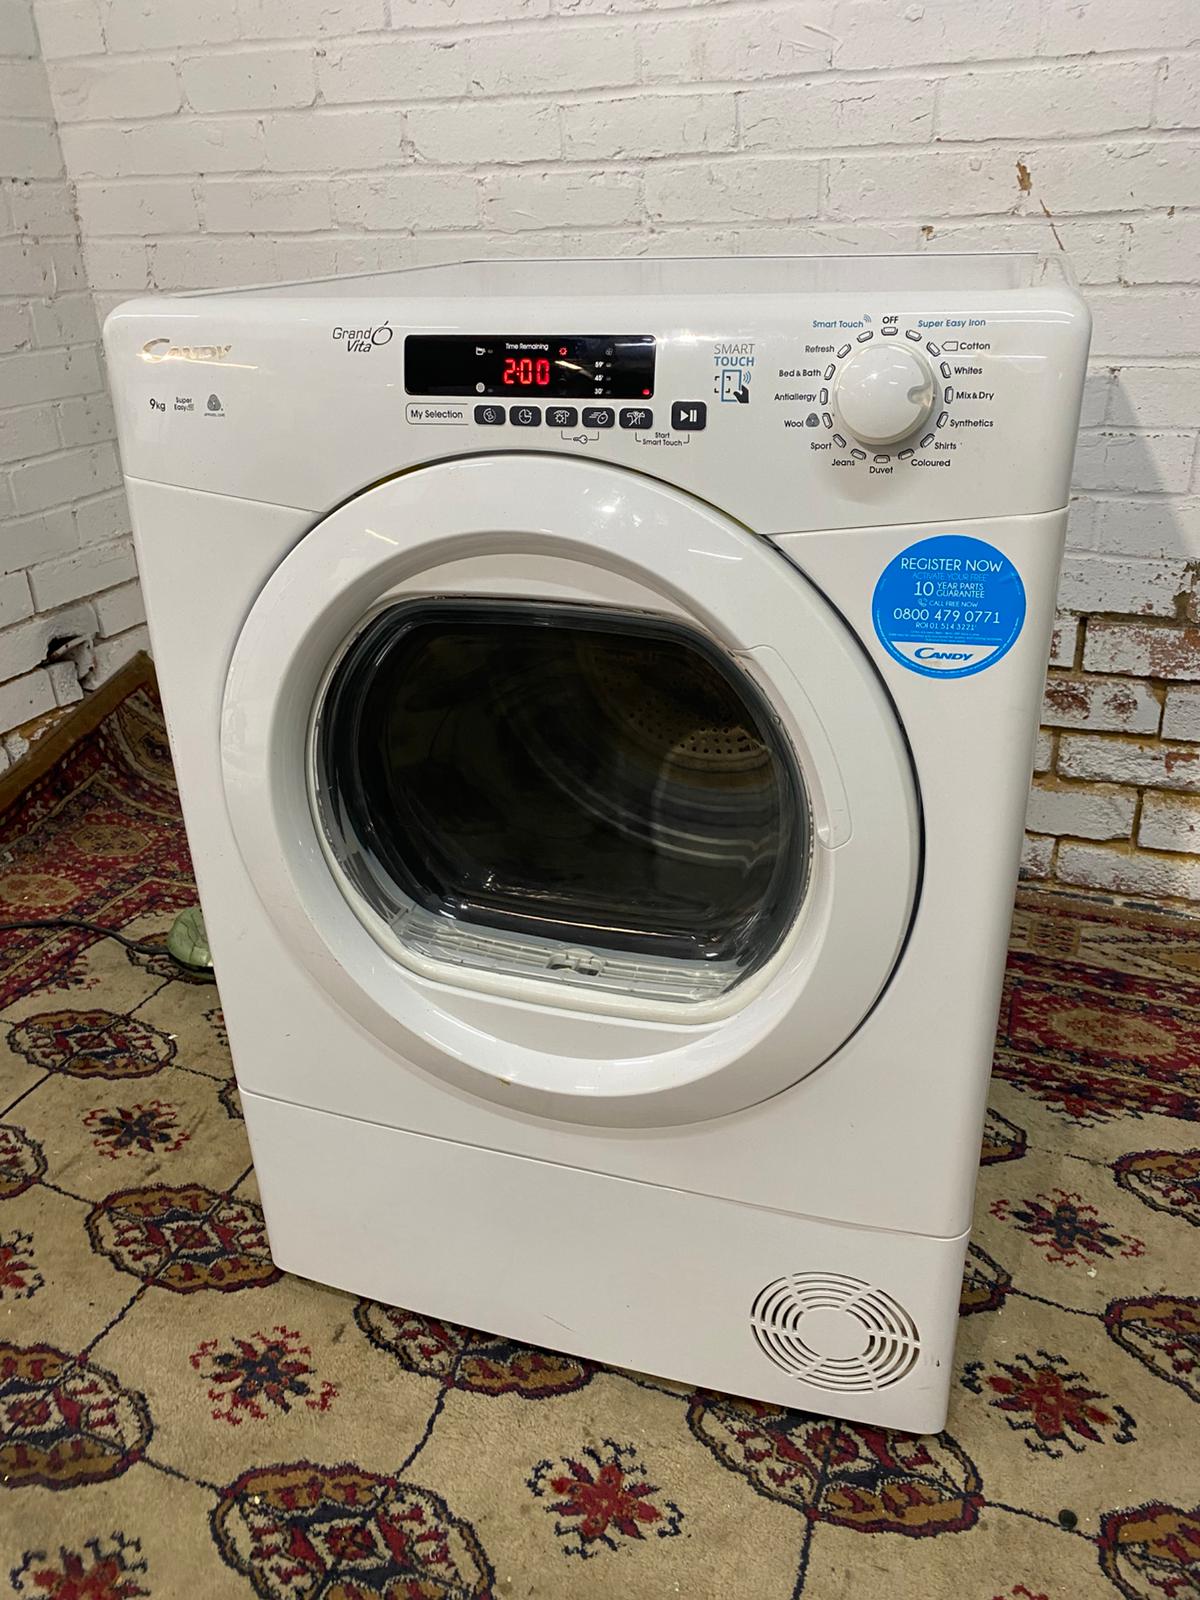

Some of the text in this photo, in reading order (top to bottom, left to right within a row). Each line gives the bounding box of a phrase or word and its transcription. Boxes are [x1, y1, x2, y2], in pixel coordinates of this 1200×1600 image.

[812, 320, 864, 328] Smart Touch
[882, 316, 899, 324] OFF
[917, 319, 986, 329] Super Easy Iron
[346, 340, 372, 352] Vita
[519, 343, 549, 351] Remaining
[713, 343, 755, 354] SMART
[804, 345, 835, 353] Refresh
[959, 342, 991, 350] Cotton
[714, 356, 755, 367] TOUCH
[503, 358, 550, 385] 2:00
[778, 369, 795, 377] Bed
[802, 369, 821, 377] Bath
[954, 366, 983, 375] Whites
[774, 393, 817, 402] Antiallergy
[174, 403, 187, 412] Easy
[410, 409, 463, 420] My Selection
[784, 420, 804, 428] Wool
[949, 419, 994, 428] Synthetics
[810, 441, 832, 451] Sport
[934, 442, 957, 450] Shirts
[910, 459, 951, 467] Coloured
[869, 466, 894, 474] Duvet
[901, 557, 1003, 573] REGISTER NOW
[947, 573, 968, 581] YOUR
[970, 574, 988, 582] FREE
[913, 581, 935, 597] 10
[936, 582, 984, 591] YEAR PARTS
[936, 590, 985, 598] GUARANTEE
[893, 608, 1000, 624] 0800 479 0771
[914, 647, 974, 661] CANDY
